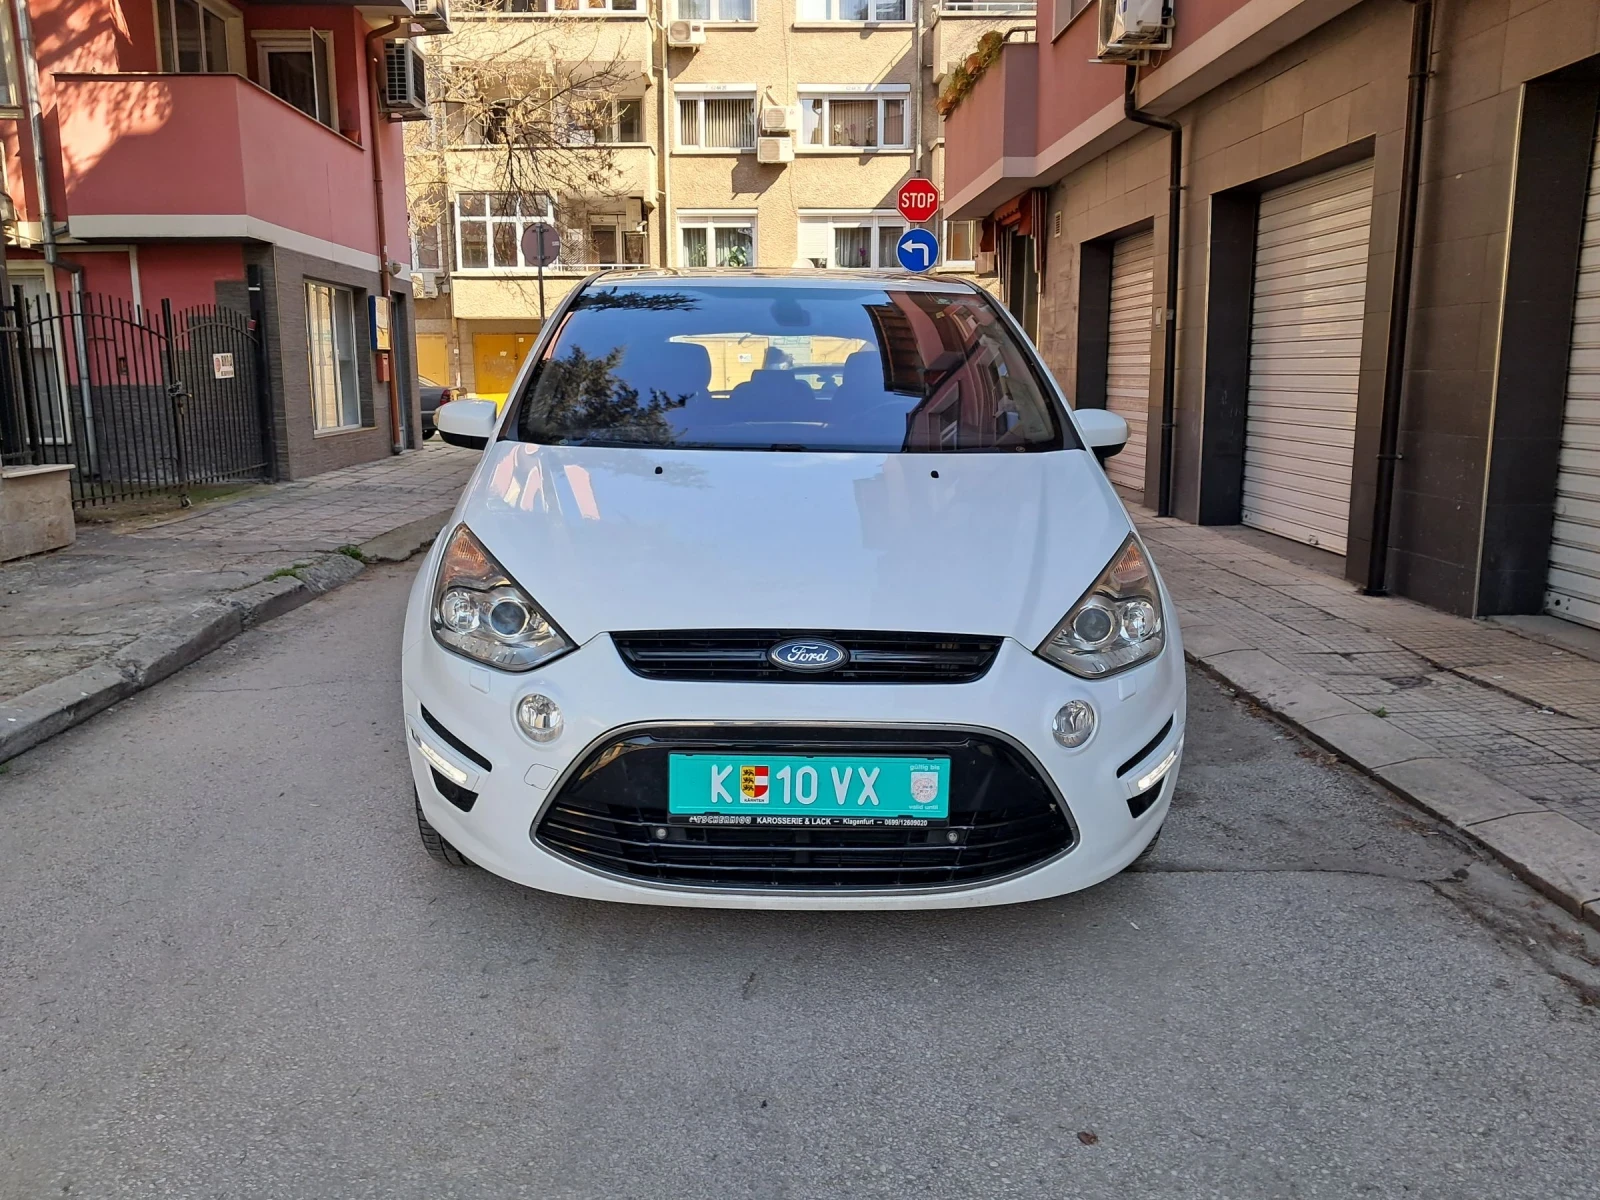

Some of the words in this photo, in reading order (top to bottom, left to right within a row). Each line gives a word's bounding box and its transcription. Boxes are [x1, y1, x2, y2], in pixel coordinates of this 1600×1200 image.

[901, 192, 935, 208] STOP
[787, 645, 829, 662] Ford
[711, 764, 733, 803] K
[776, 765, 818, 805] 10
[830, 766, 880, 806] VX
[757, 816, 803, 824] KAROSSERIE
[804, 817, 809, 825] &
[811, 817, 832, 825] LACK
[842, 817, 874, 826] Klagenfurt
